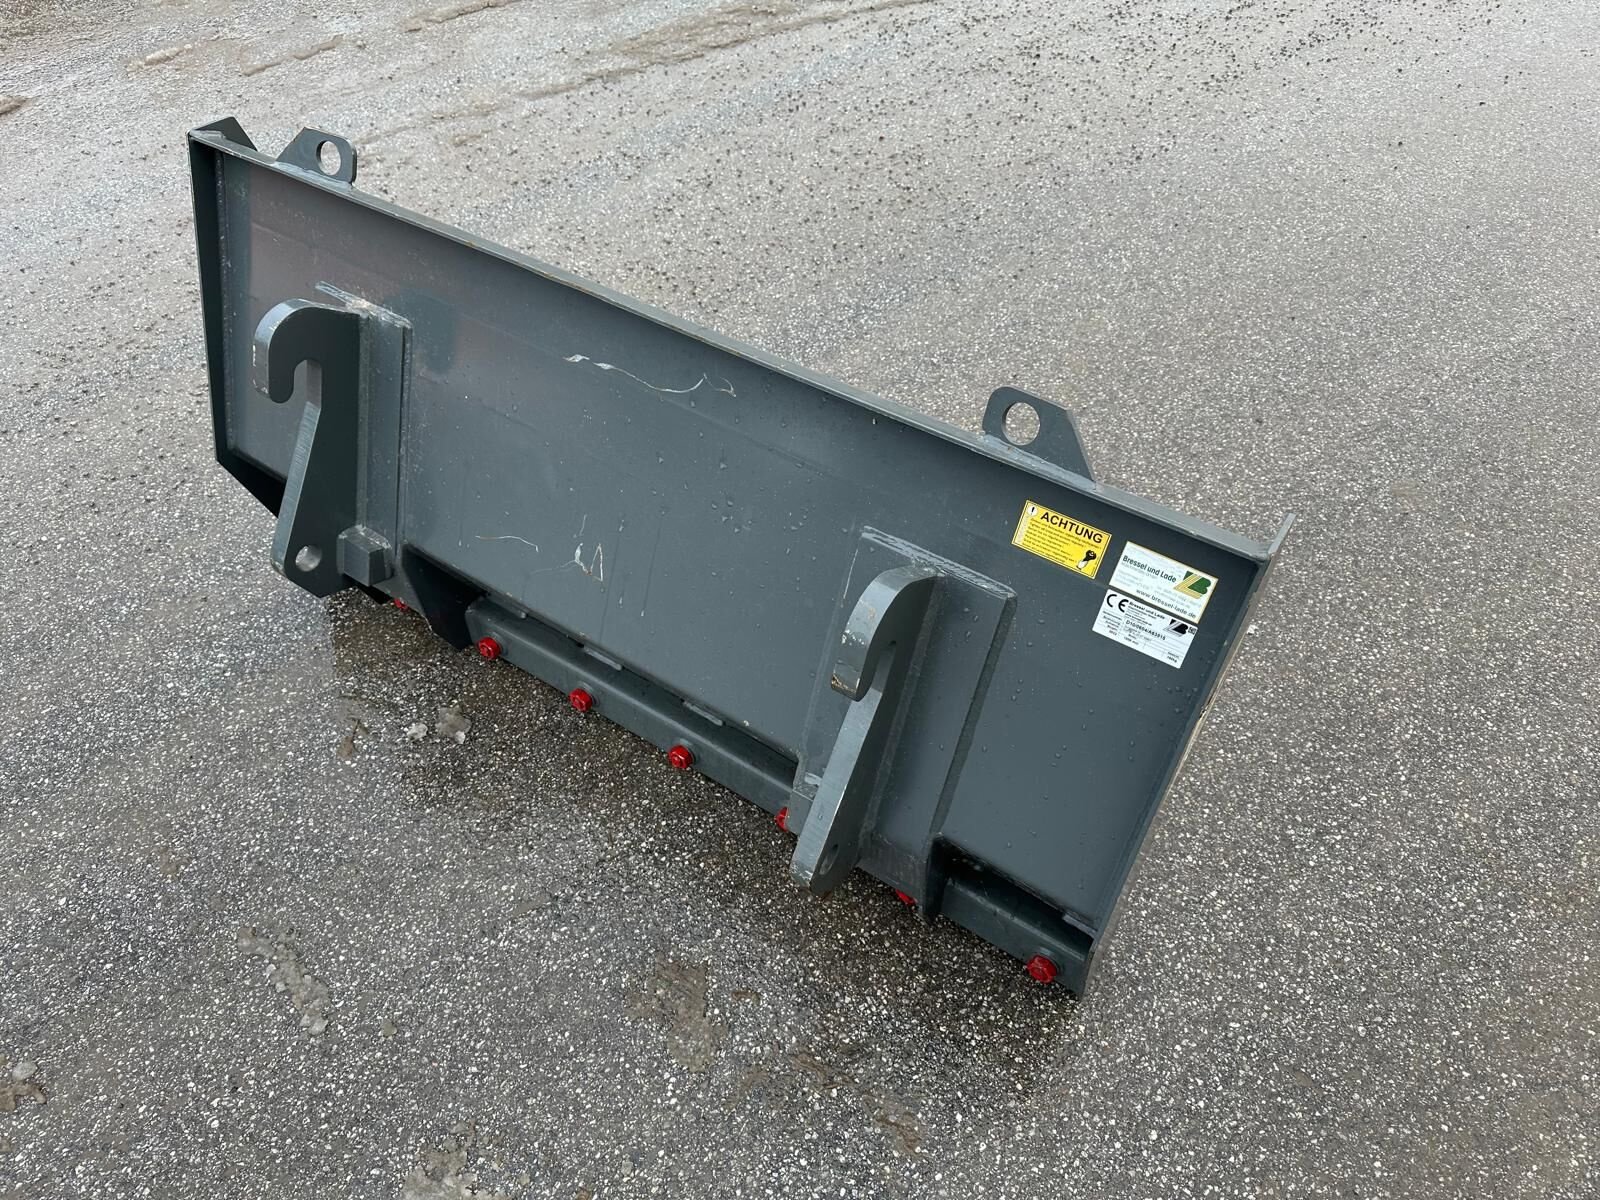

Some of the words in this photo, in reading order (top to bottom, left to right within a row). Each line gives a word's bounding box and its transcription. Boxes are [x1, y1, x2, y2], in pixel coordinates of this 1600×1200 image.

[1041, 512, 1103, 544] ACHTUNG
[1122, 555, 1147, 570] Bressel
[1146, 566, 1160, 576] und
[1160, 571, 1177, 583] Lade
[1106, 593, 1129, 612] CE
[1136, 589, 1196, 618] www.bressel-lade.de
